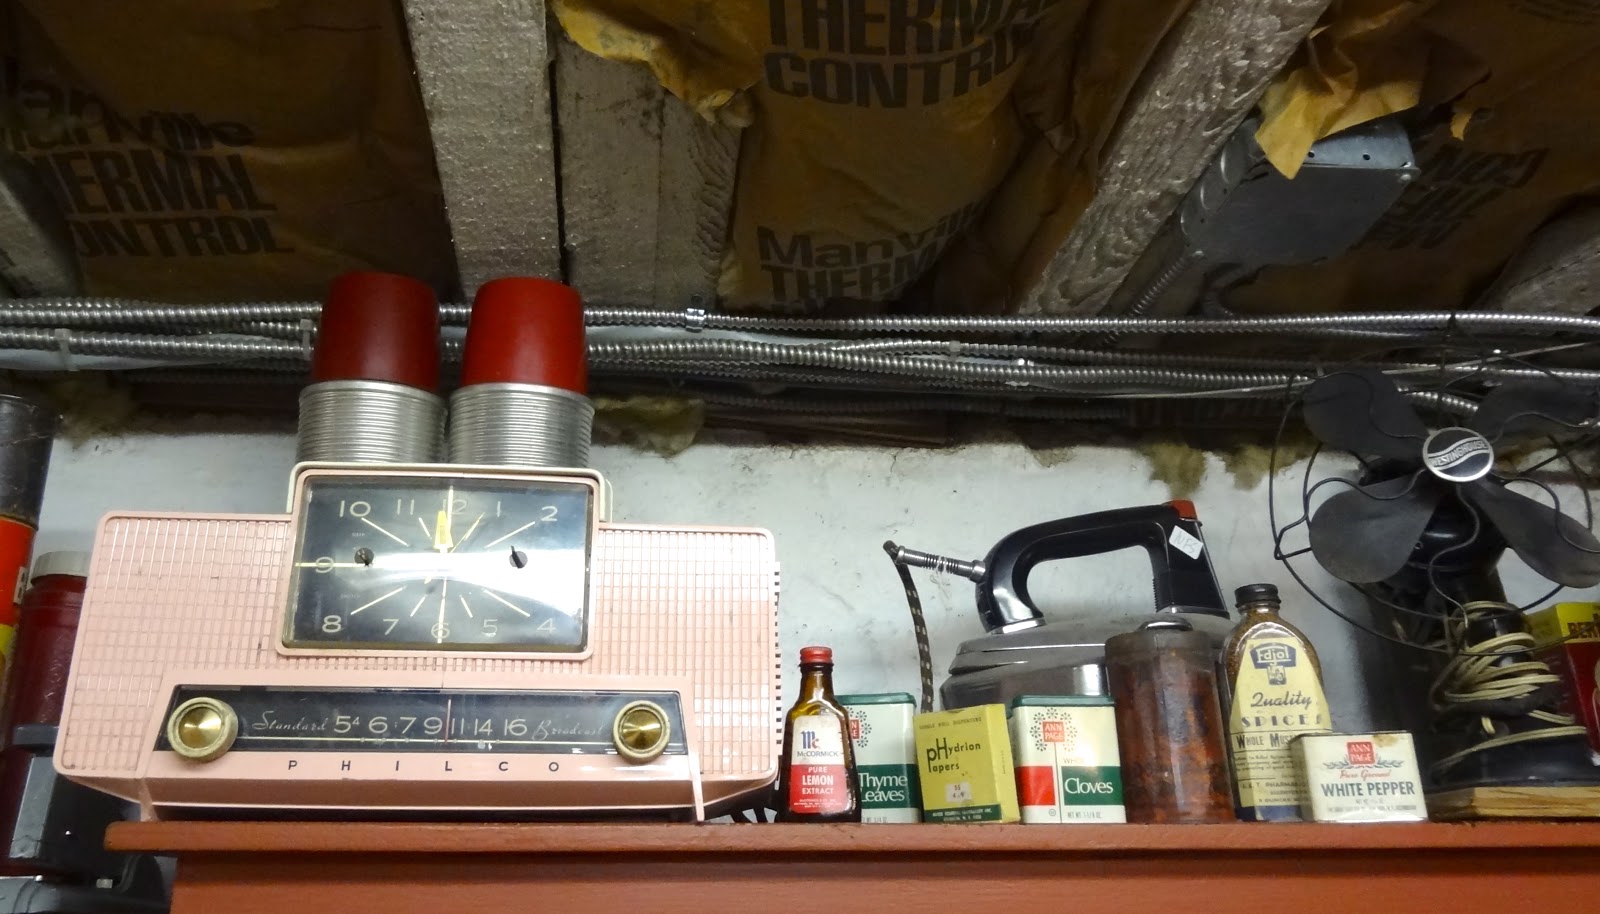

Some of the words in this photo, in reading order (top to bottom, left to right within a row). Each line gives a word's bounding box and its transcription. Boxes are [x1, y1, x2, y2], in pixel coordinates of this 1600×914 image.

[339, 499, 371, 518] 10
[396, 498, 415, 516] 11
[540, 505, 558, 522] 2
[314, 556, 335, 573] 9
[321, 614, 342, 634] 8
[382, 618, 399, 636] 7
[431, 621, 450, 639] 6
[481, 619, 498, 636] 5
[536, 617, 557, 634] 4
[1250, 690, 1312, 711] Quality
[251, 710, 329, 731] Standard
[368, 715, 389, 735] 6
[399, 716, 417, 735] 7
[423, 716, 443, 736] 9
[451, 717, 465, 736] 11
[473, 717, 493, 737] 14
[503, 717, 528, 737] 16
[1350, 744, 1371, 753] ANN
[1351, 753, 1373, 763] PAGE
[802, 774, 834, 786] LEMON
[859, 772, 908, 793] Thyme
[1064, 777, 1114, 794] Cloves
[802, 787, 834, 795] EXTRACT
[860, 788, 905, 803] Leaves
[1321, 782, 1364, 798] WHITE
[1367, 781, 1415, 797] PEPPER
